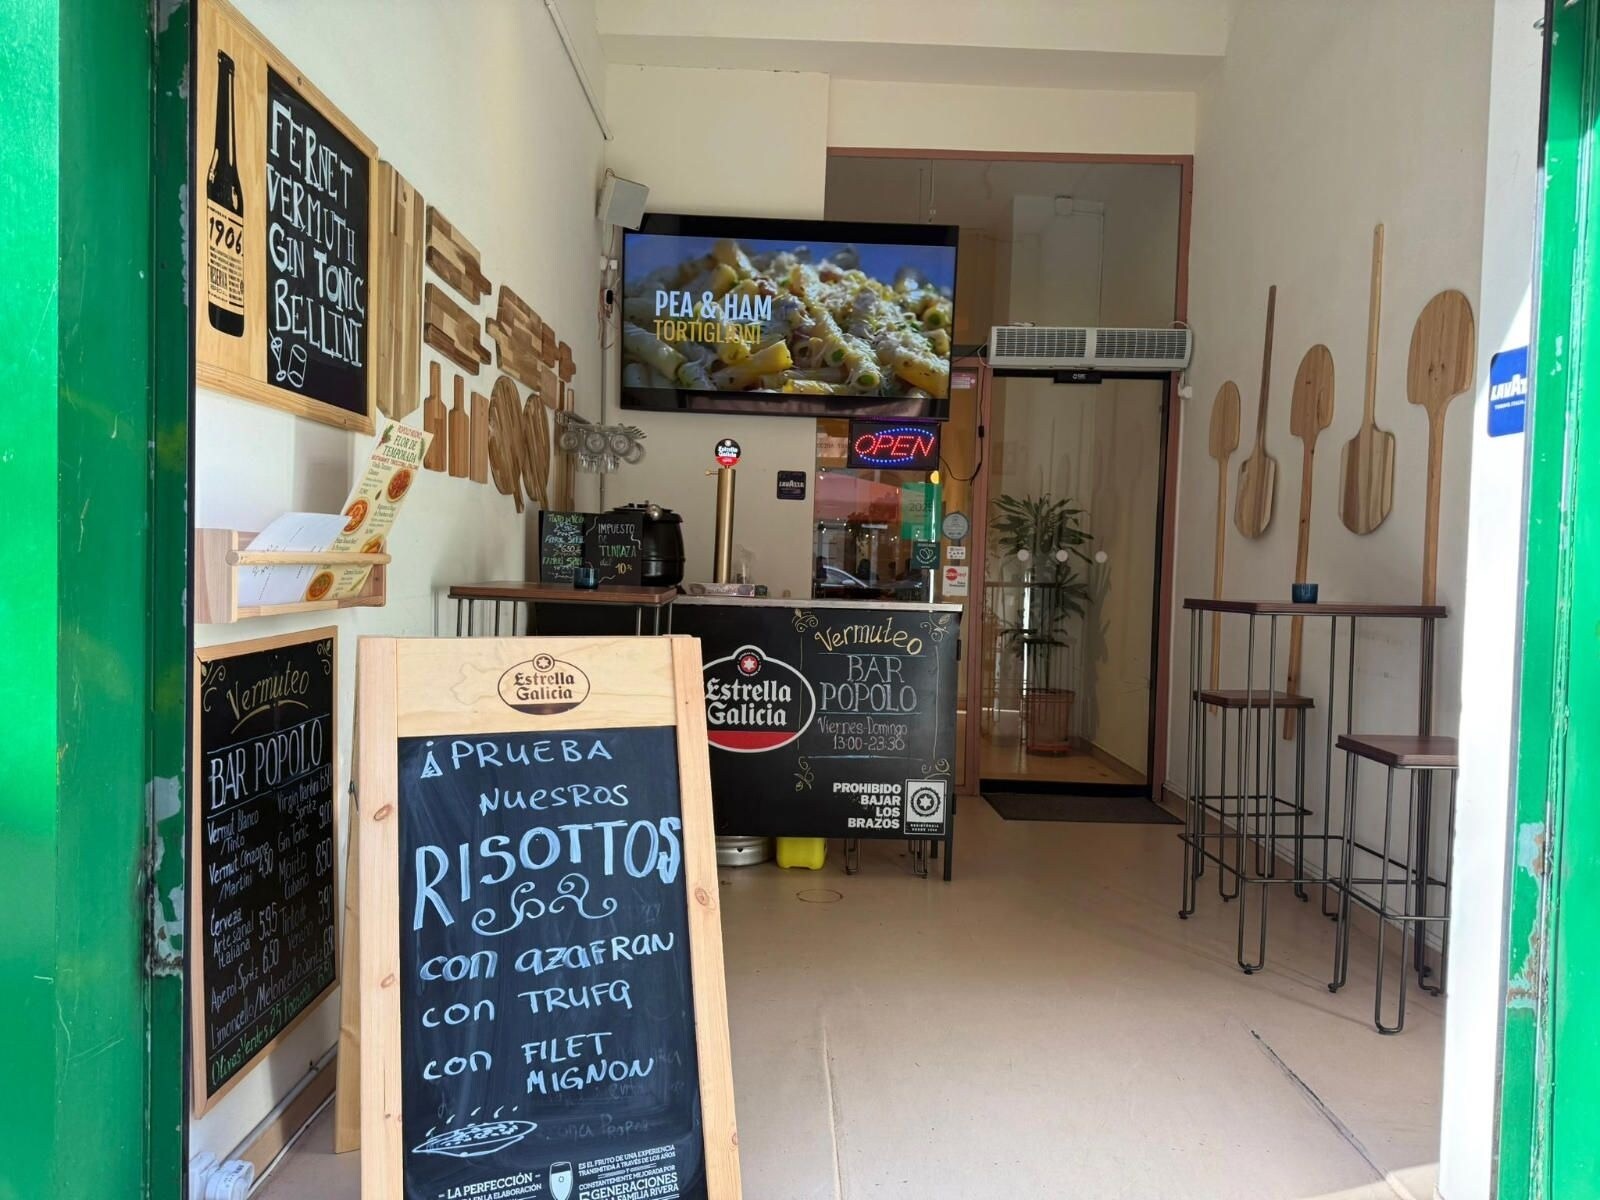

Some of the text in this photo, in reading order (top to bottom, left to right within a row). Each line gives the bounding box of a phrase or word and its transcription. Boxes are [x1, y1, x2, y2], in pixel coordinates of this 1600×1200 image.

[270, 99, 353, 208] FERNET
[267, 163, 356, 266] VERMUTH
[210, 216, 242, 255] 1906
[269, 222, 305, 279] GIN
[313, 248, 365, 318] TONIC
[655, 290, 772, 321] PEA & HAM
[274, 278, 363, 368] BELLINI
[653, 319, 761, 344] TORTIGLIONI
[855, 434, 935, 456] OPEN
[598, 523, 635, 534] IMPUESTO
[814, 617, 923, 656] Vermuteo
[513, 671, 575, 686] Estrella
[847, 655, 905, 683] BAR
[226, 660, 310, 720] Vermuteo
[516, 686, 573, 701] Galicia
[706, 677, 792, 703] Estrella
[819, 682, 918, 713] POPOLO
[707, 701, 788, 727] Galicia
[207, 719, 323, 810] BAR POPOLO
[833, 782, 901, 794] PROHIBIDO
[860, 795, 901, 806] BAJAR
[848, 818, 900, 829] BRAZOS
[875, 806, 900, 817] LOS
[413, 816, 682, 931] RISOTTOS
[210, 907, 242, 936] Cerveza
[420, 950, 498, 982] con
[422, 1000, 496, 1028] con
[423, 1032, 613, 1081] con FILET
[526, 1058, 654, 1095] MIGNON
[578, 1164, 616, 1177] TRANSMITIDA
[621, 1158, 641, 1167] TRAVÉS
[660, 1151, 676, 1159] AÑOS
[594, 1157, 616, 1166] FRUTO
[624, 1152, 637, 1160] UNA
[637, 1144, 675, 1159] EXPERIENCIA
[448, 1172, 533, 1199] LA PERFECCIÓN
[578, 1164, 676, 1190] CONSTANTEMENTE MEJORADA POR
[591, 1172, 678, 1199] GENERACIONES
[650, 1183, 680, 1196] RIVERA
[493, 1183, 542, 1200] ELABORACIÓN
